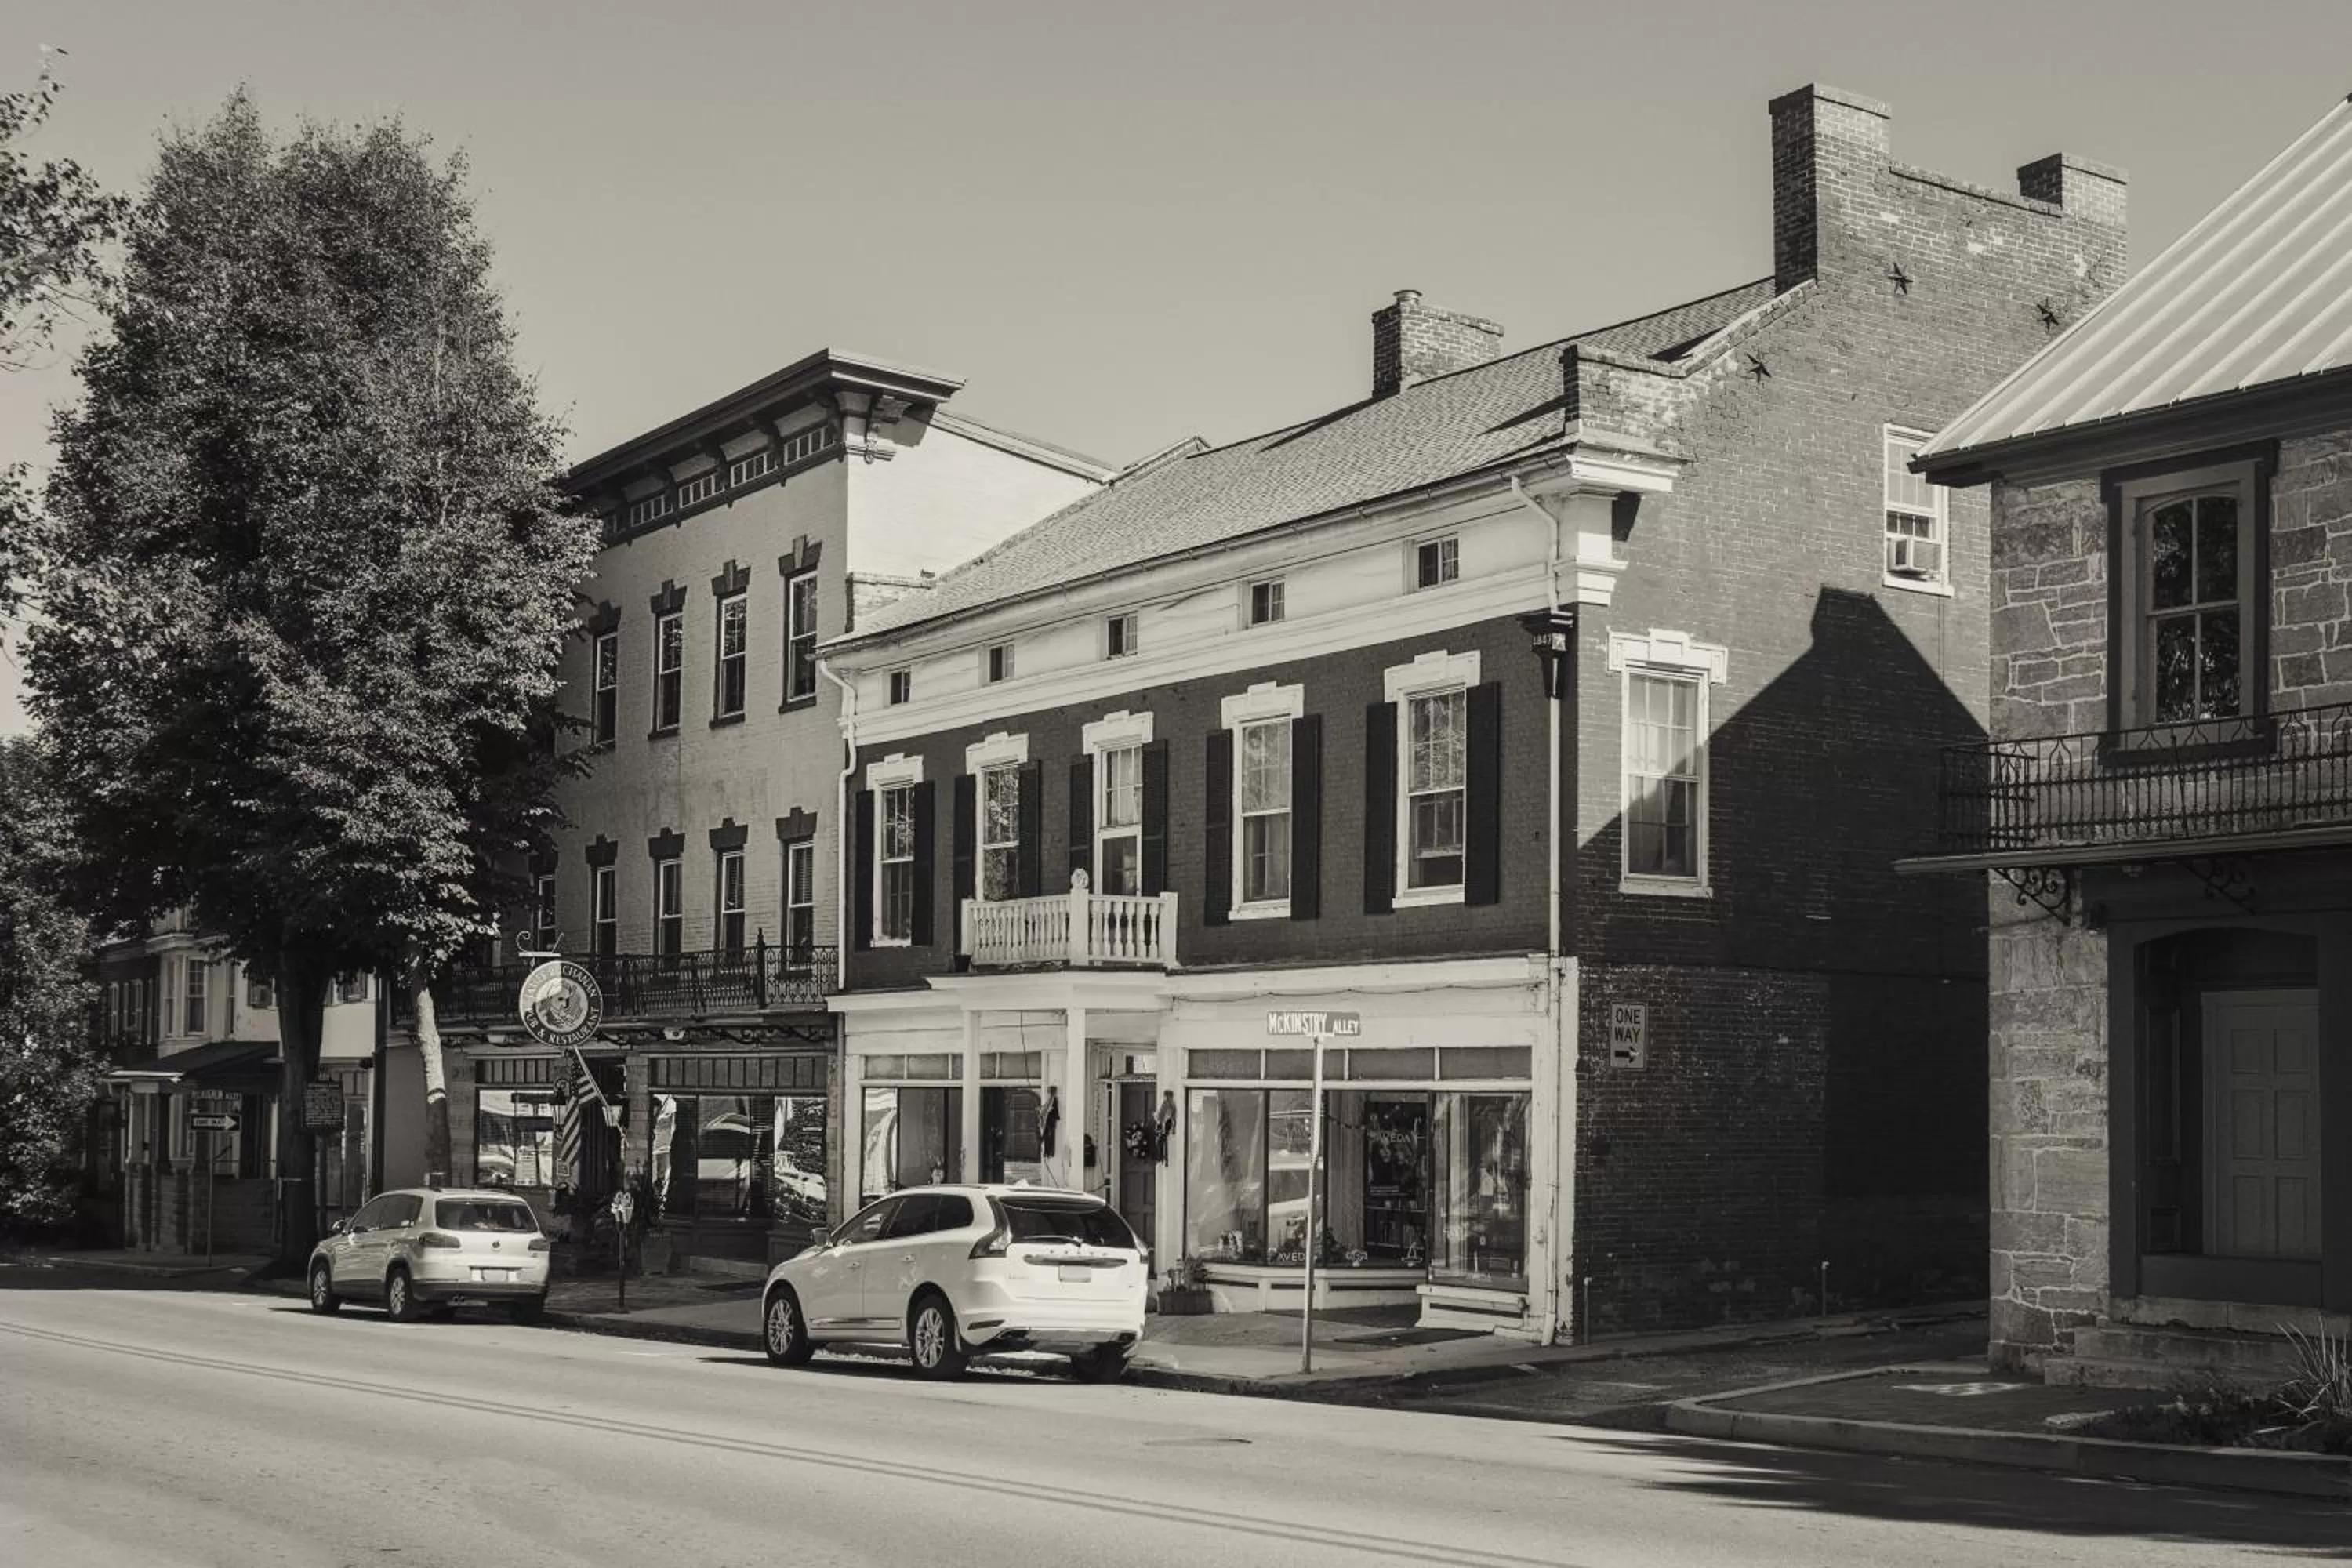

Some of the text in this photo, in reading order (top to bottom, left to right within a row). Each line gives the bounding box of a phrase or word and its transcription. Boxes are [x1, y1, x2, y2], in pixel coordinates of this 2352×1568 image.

[537, 1028, 546, 1038] &
[549, 1007, 600, 1044] RESTAURANT
[1269, 1012, 1359, 1035] McKINSTRY ALLEY
[1615, 1007, 1641, 1024] ONE
[1614, 1027, 1641, 1043] WAY
